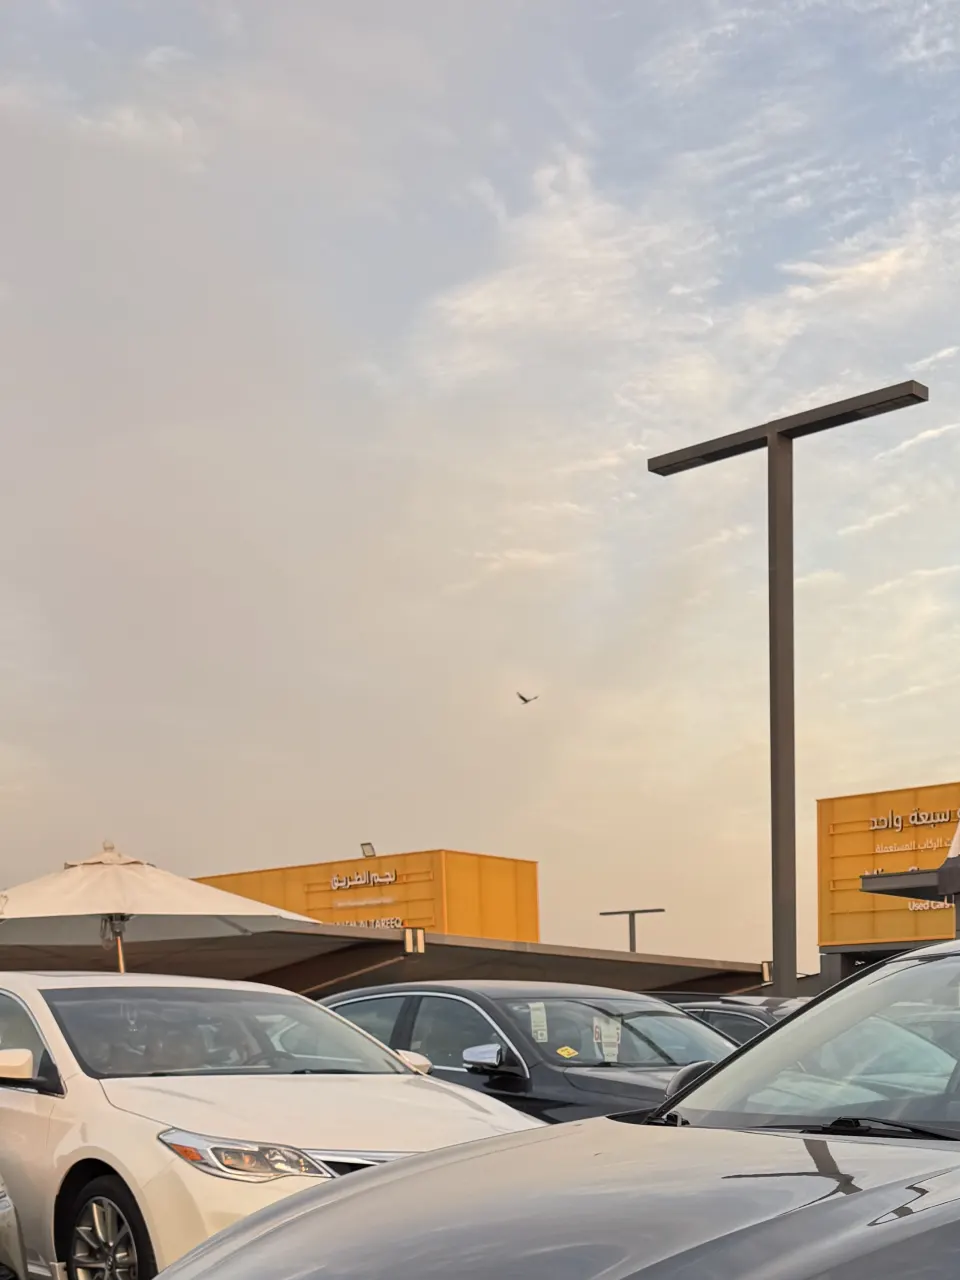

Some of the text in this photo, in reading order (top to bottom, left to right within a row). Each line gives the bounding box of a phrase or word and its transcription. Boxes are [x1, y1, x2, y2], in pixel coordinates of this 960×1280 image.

[870, 808, 904, 832] واحد
[909, 807, 951, 828] سبعة
[908, 900, 929, 911] Used
